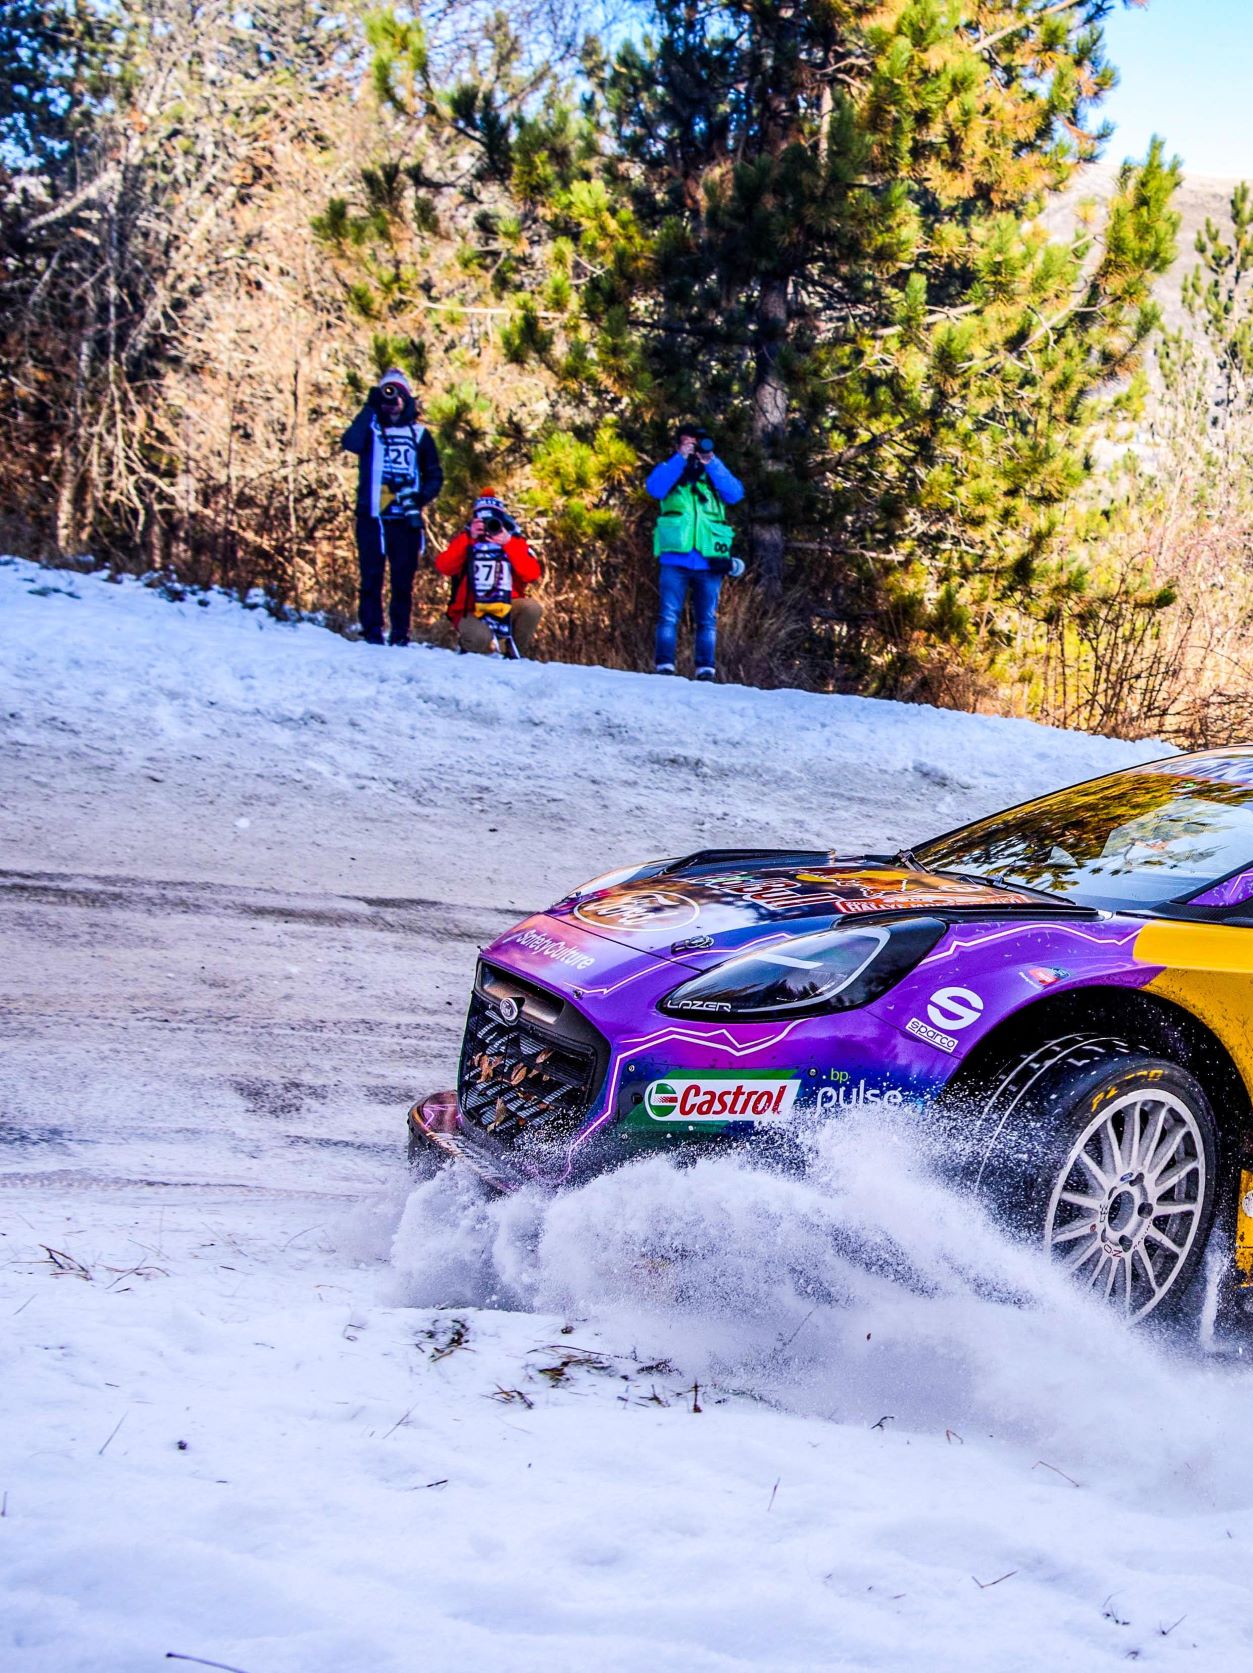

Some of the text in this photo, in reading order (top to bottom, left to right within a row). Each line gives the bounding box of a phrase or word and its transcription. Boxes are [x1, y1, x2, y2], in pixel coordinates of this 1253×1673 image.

[516, 929, 596, 970] SafetyCulture
[667, 1000, 732, 1013] LAZER
[909, 1020, 956, 1049] sparco
[830, 1067, 849, 1083] bp
[679, 1084, 788, 1116] Castrol
[815, 1079, 903, 1118] pulse
